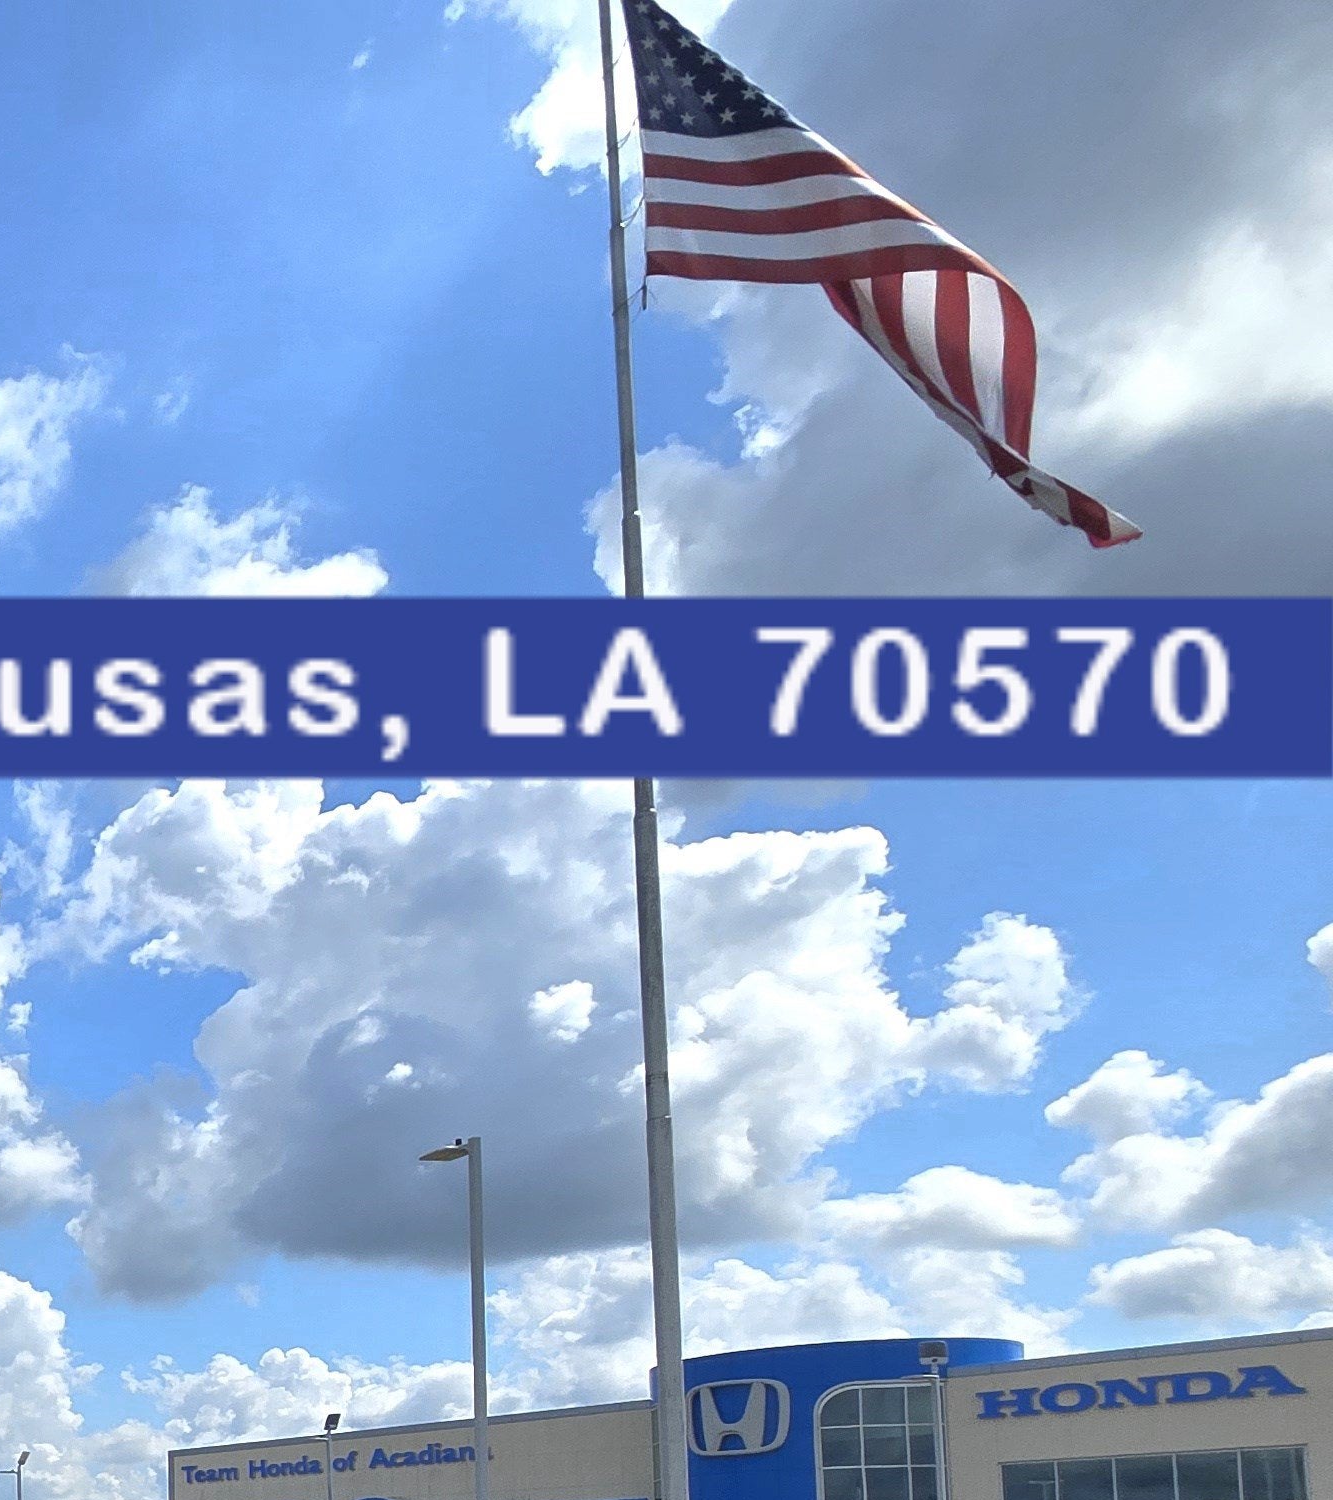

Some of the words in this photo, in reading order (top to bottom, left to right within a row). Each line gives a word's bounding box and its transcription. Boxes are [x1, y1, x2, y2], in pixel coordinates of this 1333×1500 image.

[976, 1365, 1307, 1420] HONDA
[182, 1465, 238, 1484] Team
[249, 1455, 323, 1480] Honda
[333, 1451, 357, 1472] of
[369, 1443, 494, 1469] Acadian
